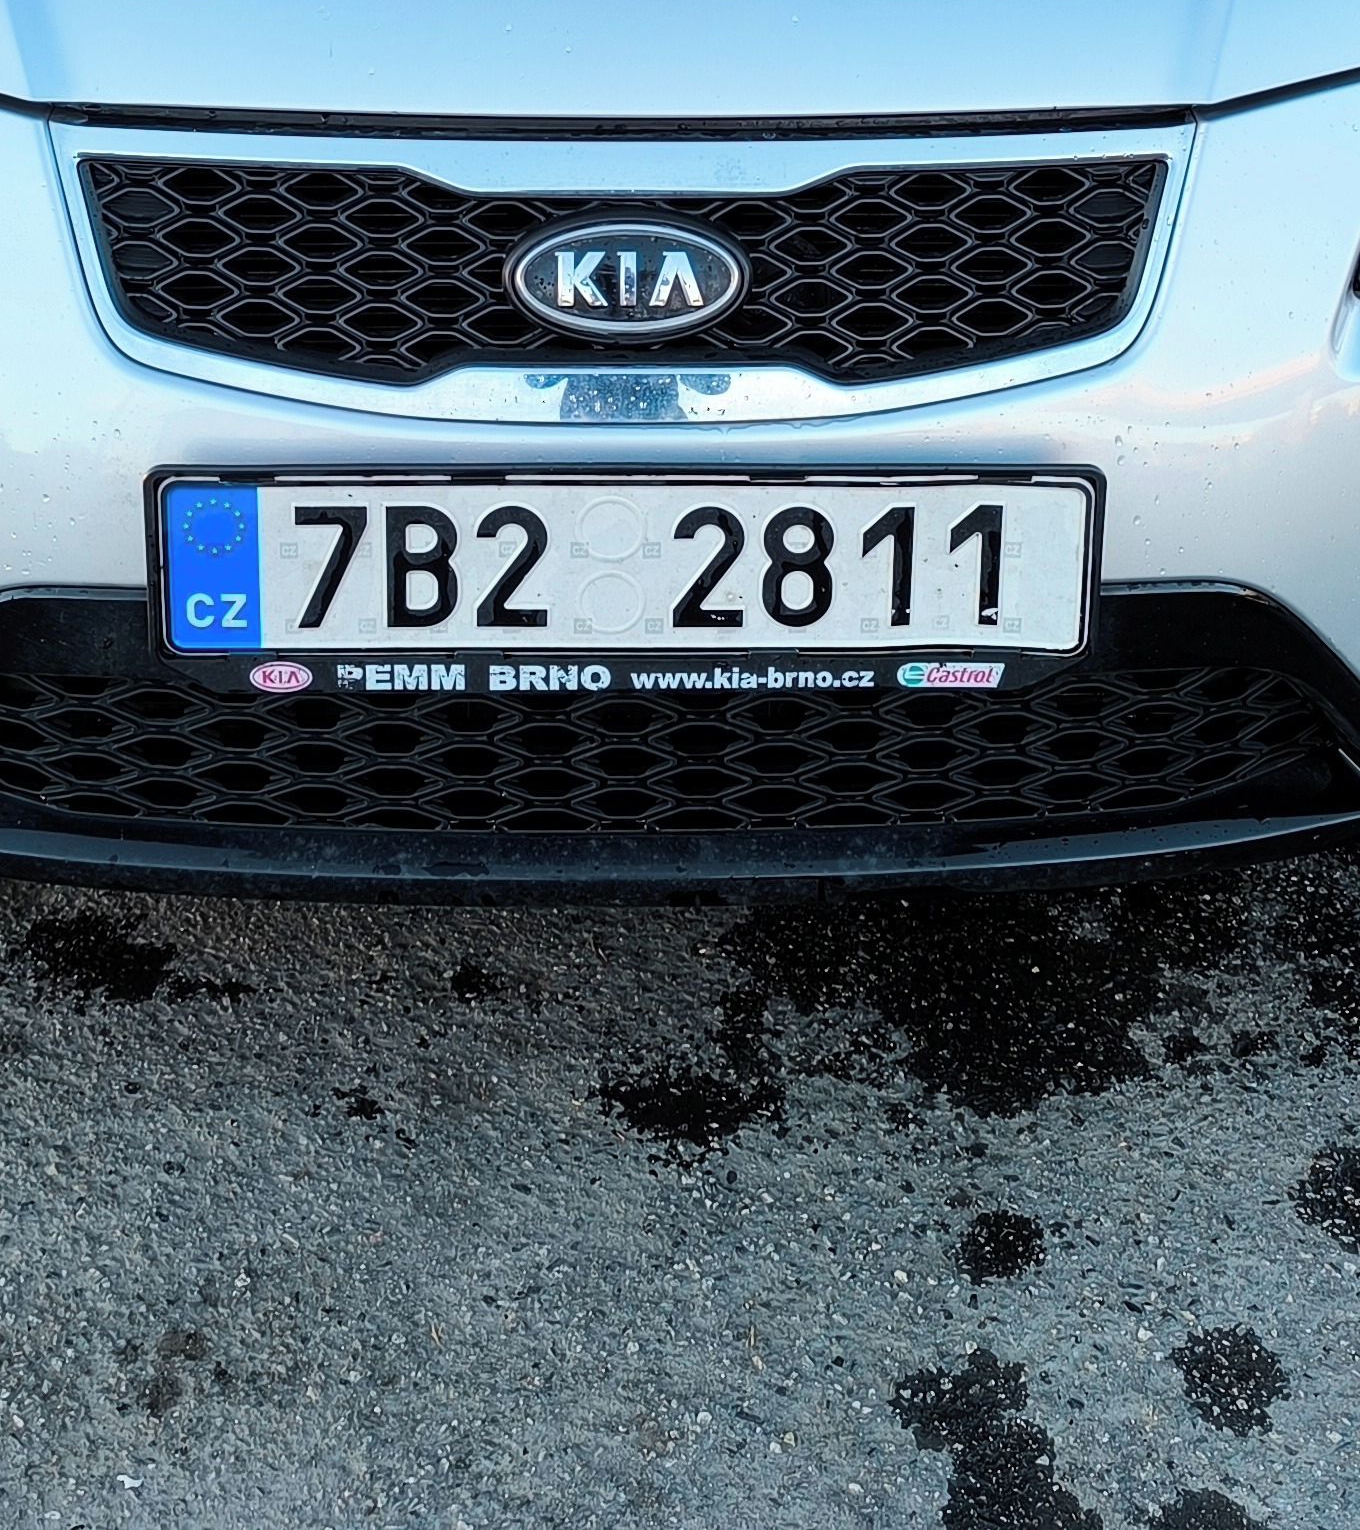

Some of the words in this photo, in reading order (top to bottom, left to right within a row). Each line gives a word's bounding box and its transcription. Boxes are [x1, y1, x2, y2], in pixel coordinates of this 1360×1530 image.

[554, 251, 705, 308] KIA
[293, 505, 549, 629] 7B2
[672, 504, 1004, 628] 2811
[185, 592, 248, 628] CZ
[489, 664, 611, 692] BRNO
[630, 666, 875, 690] www.kia-brno.cz
[926, 666, 994, 684] Castrol
